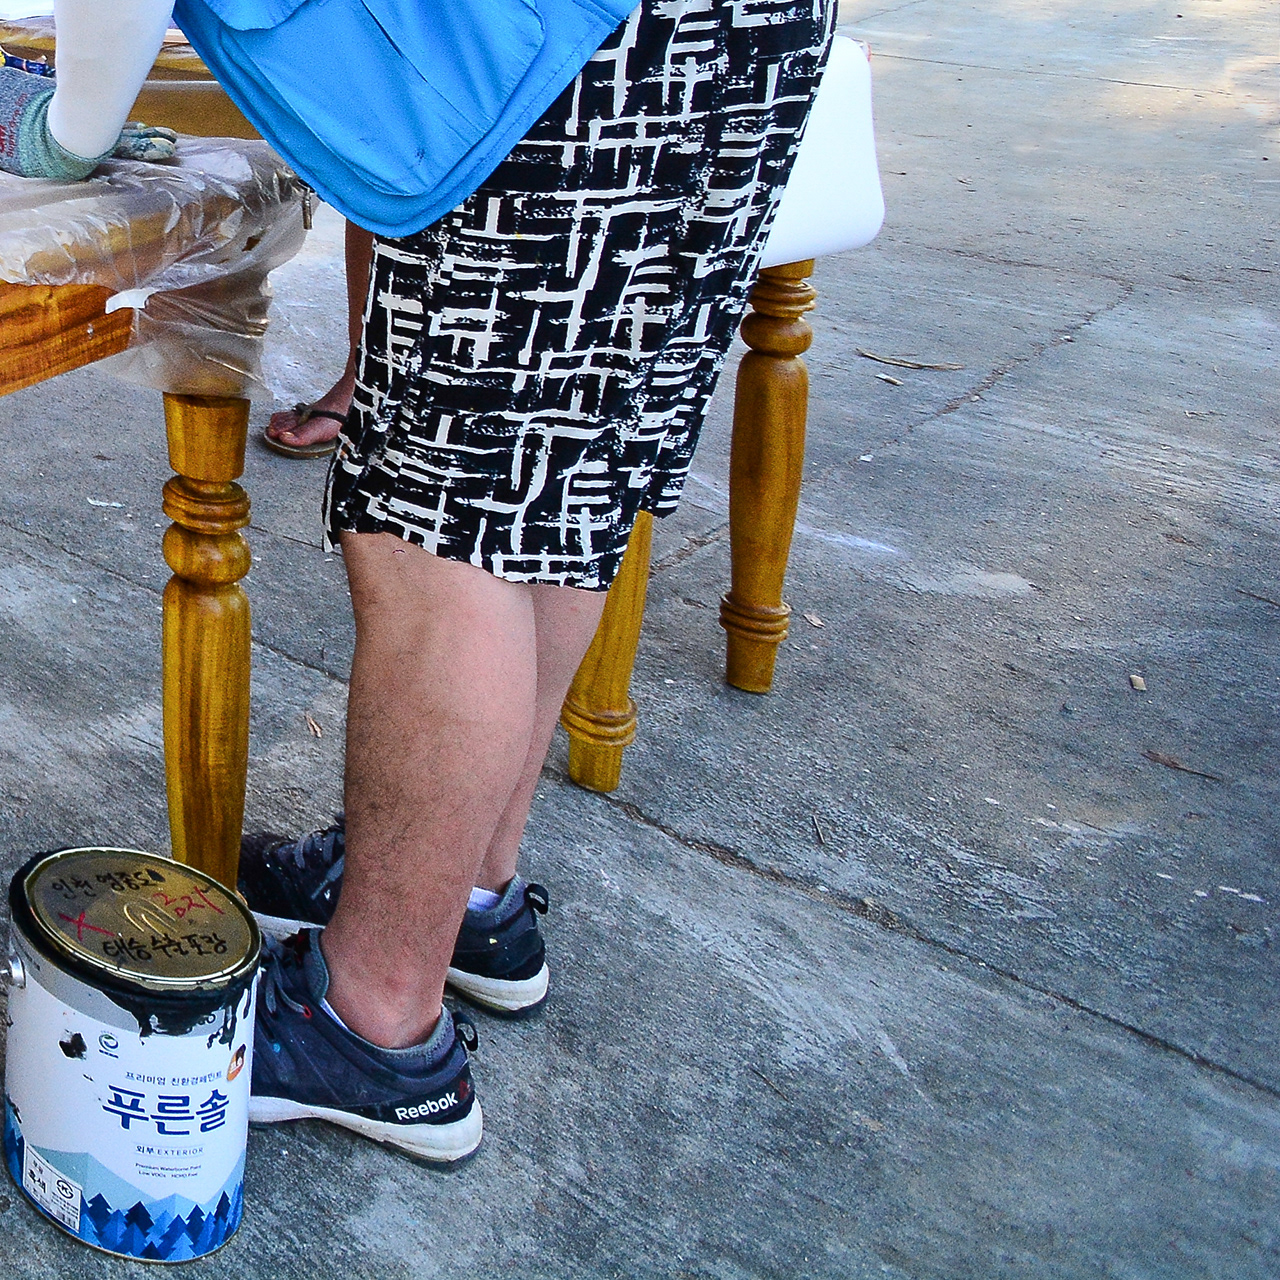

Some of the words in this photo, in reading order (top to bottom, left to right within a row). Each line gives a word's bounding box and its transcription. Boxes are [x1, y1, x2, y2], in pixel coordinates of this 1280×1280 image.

[126, 1071, 166, 1086] 프리미엄
[102, 1085, 230, 1135] 푸른솔
[394, 1092, 459, 1121] Reebok
[157, 1147, 203, 1156] EXTERIOR
